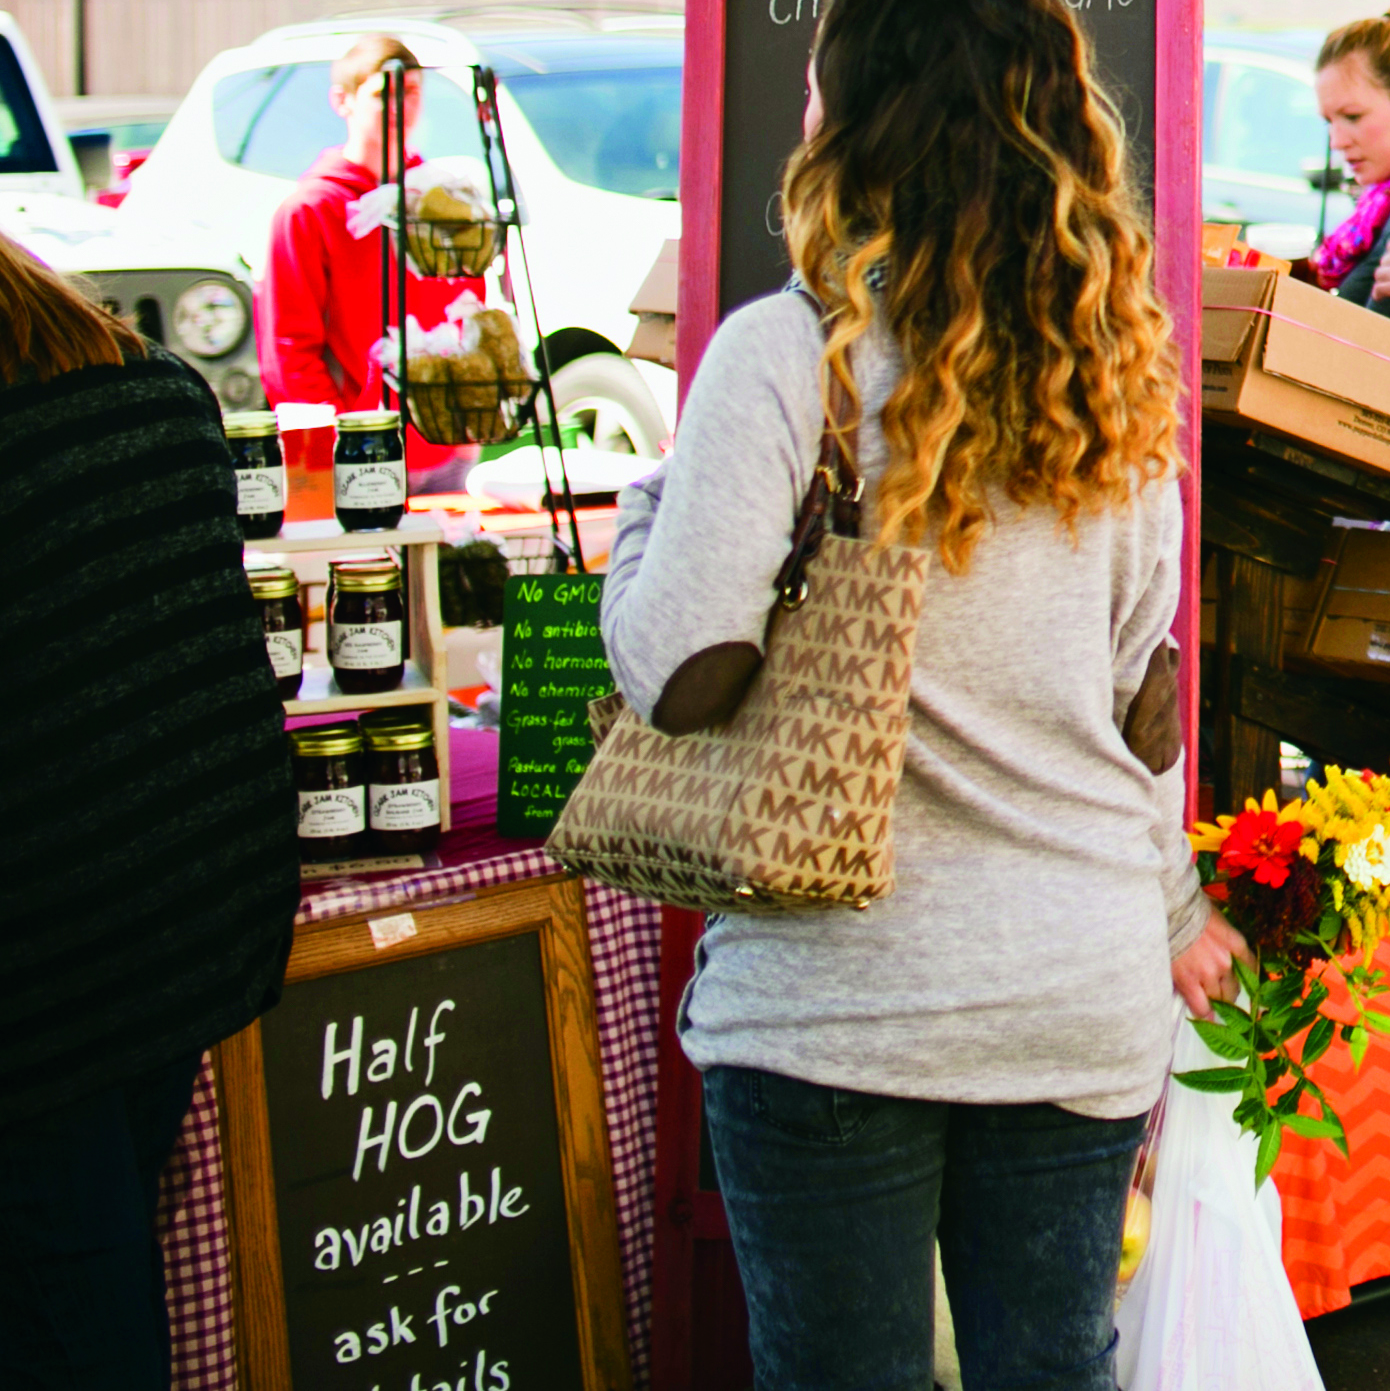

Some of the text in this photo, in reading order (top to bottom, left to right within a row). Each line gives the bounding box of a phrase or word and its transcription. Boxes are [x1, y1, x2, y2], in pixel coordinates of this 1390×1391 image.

[517, 580, 601, 606] No GMO
[845, 580, 895, 617] MK
[514, 619, 532, 639] No
[814, 612, 915, 656] MK MK
[511, 649, 533, 670] No
[827, 652, 878, 690] MK
[510, 680, 529, 697] No
[508, 756, 557, 773] Pasture
[786, 718, 899, 772] MK MK
[511, 780, 566, 799] LOCAL
[799, 760, 861, 804] MK
[524, 804, 554, 819] from
[756, 787, 875, 844] MK MK
[717, 817, 882, 879] MK MK MK
[322, 1000, 456, 1100] Half
[352, 1082, 492, 1183] HOG
[313, 1167, 530, 1271] available
[334, 1285, 499, 1364] ask for
